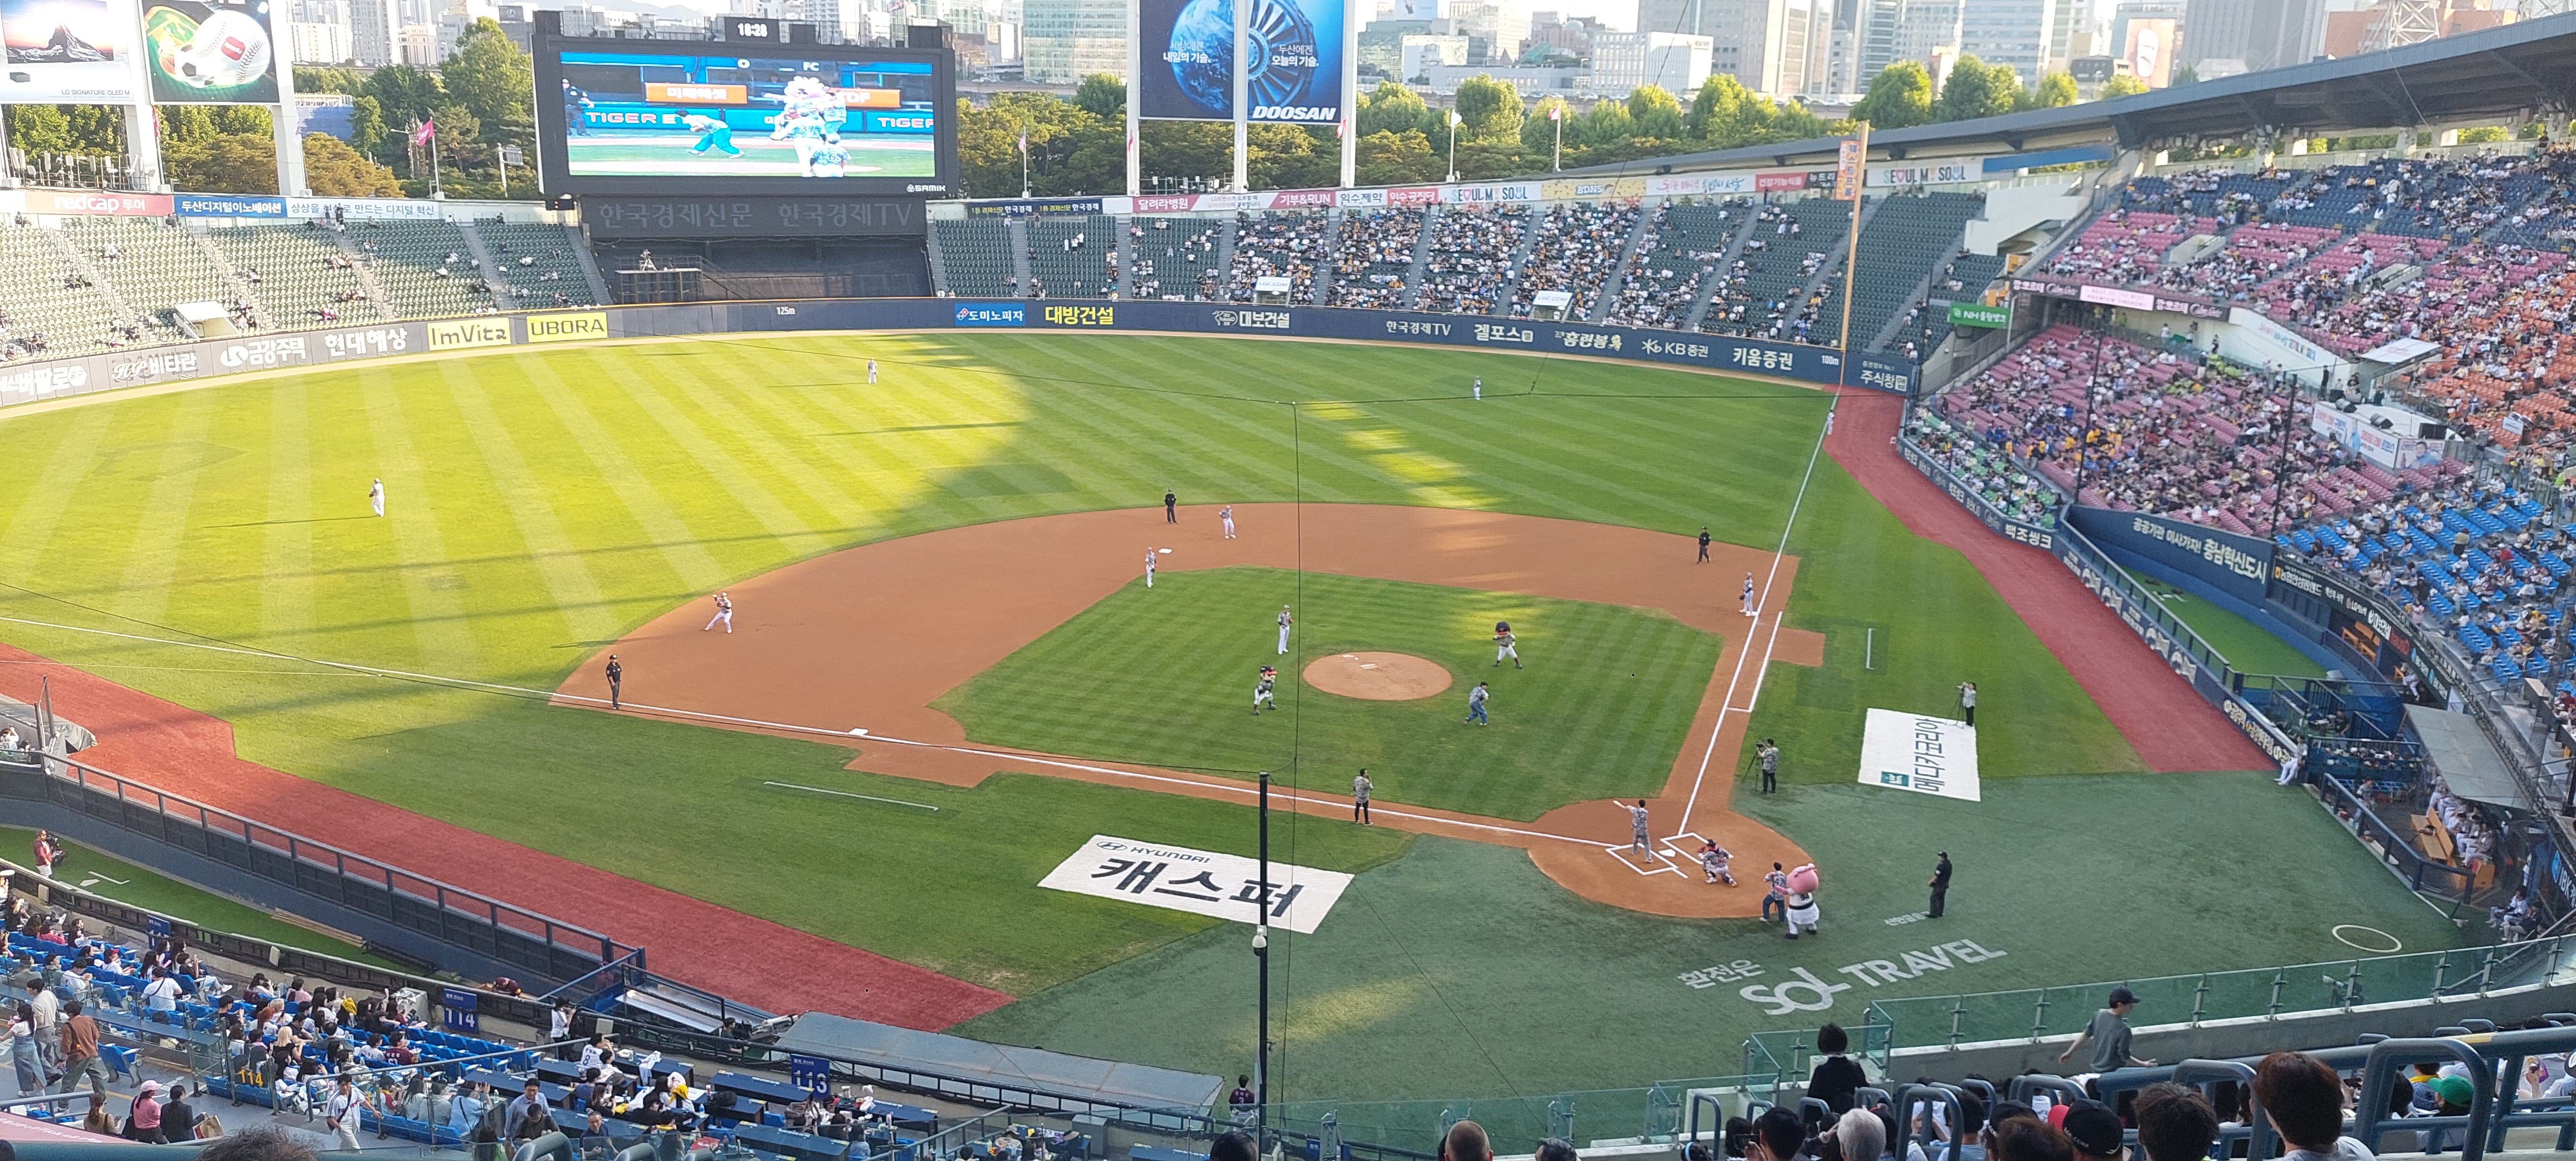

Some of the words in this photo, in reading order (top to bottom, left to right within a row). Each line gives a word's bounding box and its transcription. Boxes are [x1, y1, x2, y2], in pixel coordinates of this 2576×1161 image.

[738, 23, 768, 37] 18:28
[1164, 52, 1189, 63] 내일의
[1279, 45, 1313, 55] 두산에겐
[1271, 56, 1297, 66] 오늘의
[586, 111, 657, 124] TIGER
[1252, 106, 1336, 120] DOOSAN
[54, 196, 119, 214] redcap
[122, 199, 145, 211] 투어
[1139, 198, 1188, 210] 달려라병원
[1340, 193, 1382, 203] 익수제약
[181, 201, 281, 213] 두산디지털이노베이션
[291, 203, 319, 214] 상상을
[355, 204, 383, 214] 만드는
[387, 205, 413, 215] 디지털
[417, 205, 435, 216] 혁신
[598, 203, 754, 228] 한국경제신문
[780, 203, 912, 227] 한국경제TV
[777, 306, 796, 315] 125m
[969, 309, 1024, 323] 도미노피자
[1045, 306, 1114, 325] 대방건설
[530, 318, 605, 335] UBORA
[1240, 311, 1290, 328] 대보건설
[432, 324, 507, 345] ImVita
[1386, 321, 1451, 336] 한국경제TV
[248, 336, 306, 365] 금강주택
[325, 328, 407, 357] 현대해상
[149, 352, 197, 375] 비타란
[1733, 348, 1793, 371] 키움증권
[1821, 355, 1839, 365] 100m
[2006, 524, 2052, 549] 백조씽크
[2133, 517, 2165, 540] 공공기관
[2204, 538, 2267, 584] 충남혁신도시
[1913, 718, 1945, 793] 메디카코리아
[1130, 847, 1210, 864] HYUNDAI
[1090, 857, 1305, 917] 캐스퍼
[1677, 959, 1765, 989] 환전은
[1740, 967, 1852, 1015] SOL
[1838, 939, 2008, 987] TRAVEL
[446, 1008, 475, 1028] 114
[239, 1070, 263, 1087] 114
[793, 1070, 827, 1094] 113
